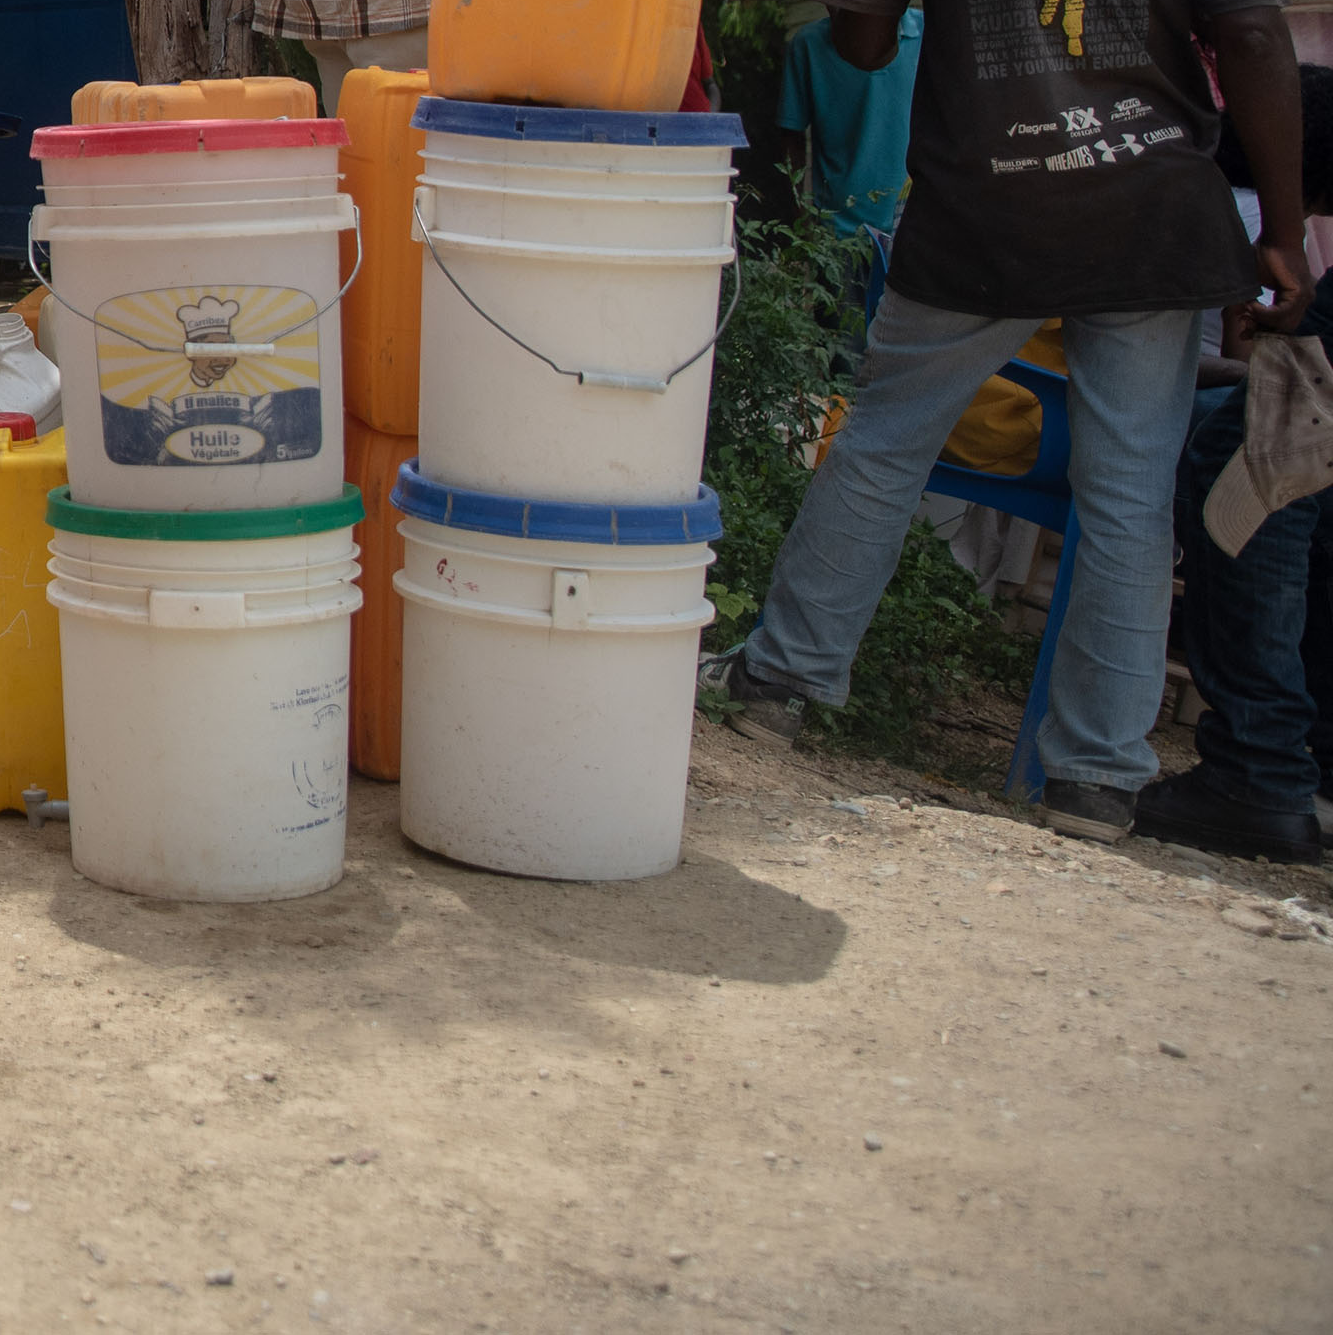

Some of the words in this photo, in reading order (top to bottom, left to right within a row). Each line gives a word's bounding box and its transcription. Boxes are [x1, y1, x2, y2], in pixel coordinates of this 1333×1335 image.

[1018, 122, 1059, 136] Degree
[1044, 145, 1096, 173] WHEATIES
[190, 431, 242, 448] Huile
[190, 447, 240, 461] Végétale
[276, 444, 288, 460] 5
